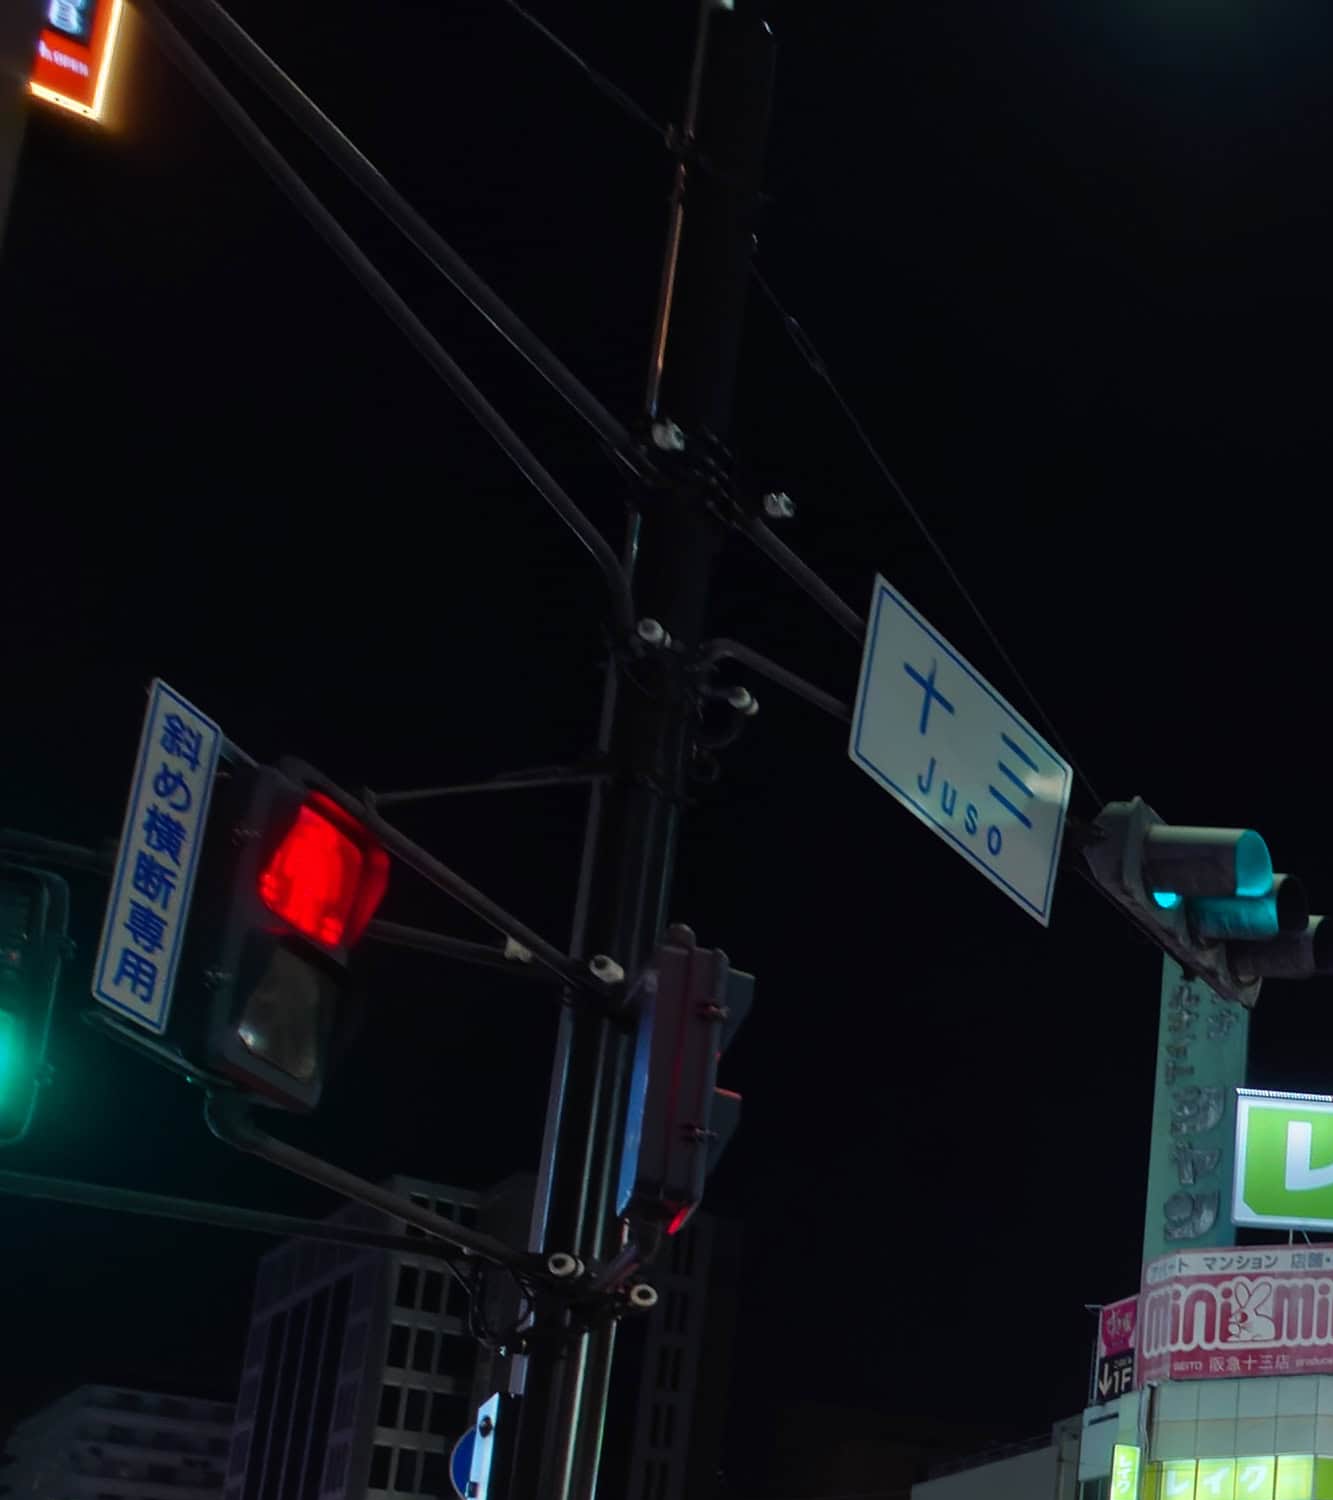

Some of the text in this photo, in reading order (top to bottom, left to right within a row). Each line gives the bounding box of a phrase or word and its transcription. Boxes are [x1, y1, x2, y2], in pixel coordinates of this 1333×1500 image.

[917, 757, 1003, 856] JUSO
[1202, 1254, 1279, 1271] マンション
[1117, 1452, 1132, 1496] レイク
[1165, 1467, 1267, 1497] レイク
